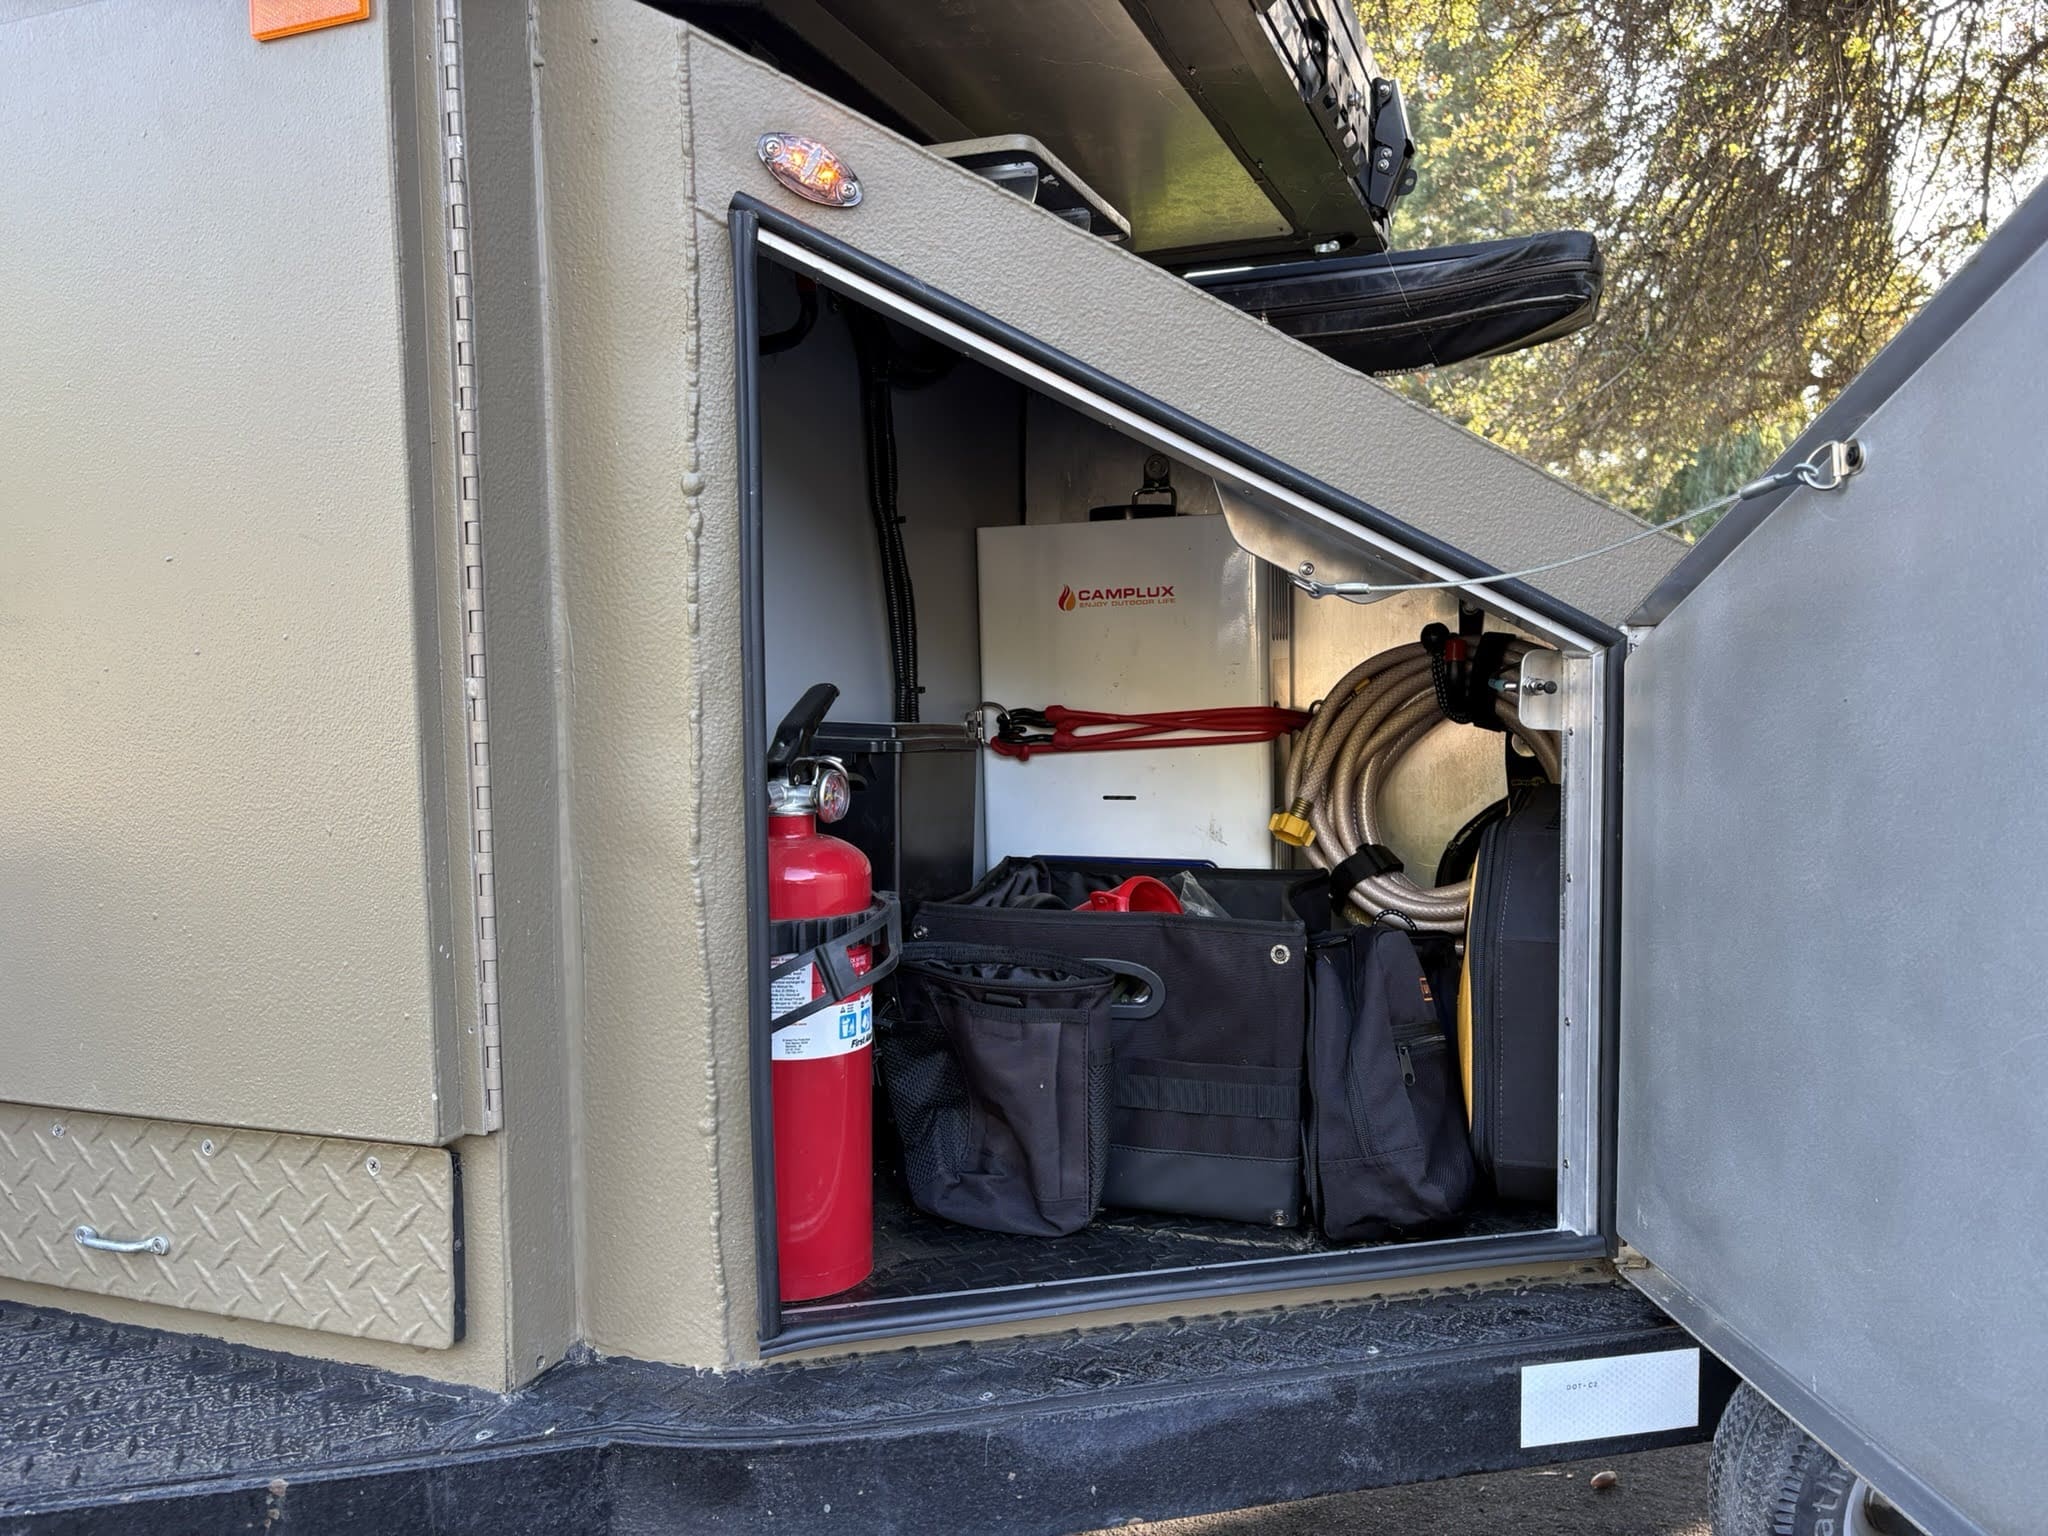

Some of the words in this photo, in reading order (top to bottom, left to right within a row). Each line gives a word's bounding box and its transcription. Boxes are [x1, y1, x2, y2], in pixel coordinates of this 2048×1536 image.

[1079, 585, 1175, 601] CAMPLUX
[1111, 599, 1155, 607] OUTDOOR
[1157, 597, 1176, 605] LIFE
